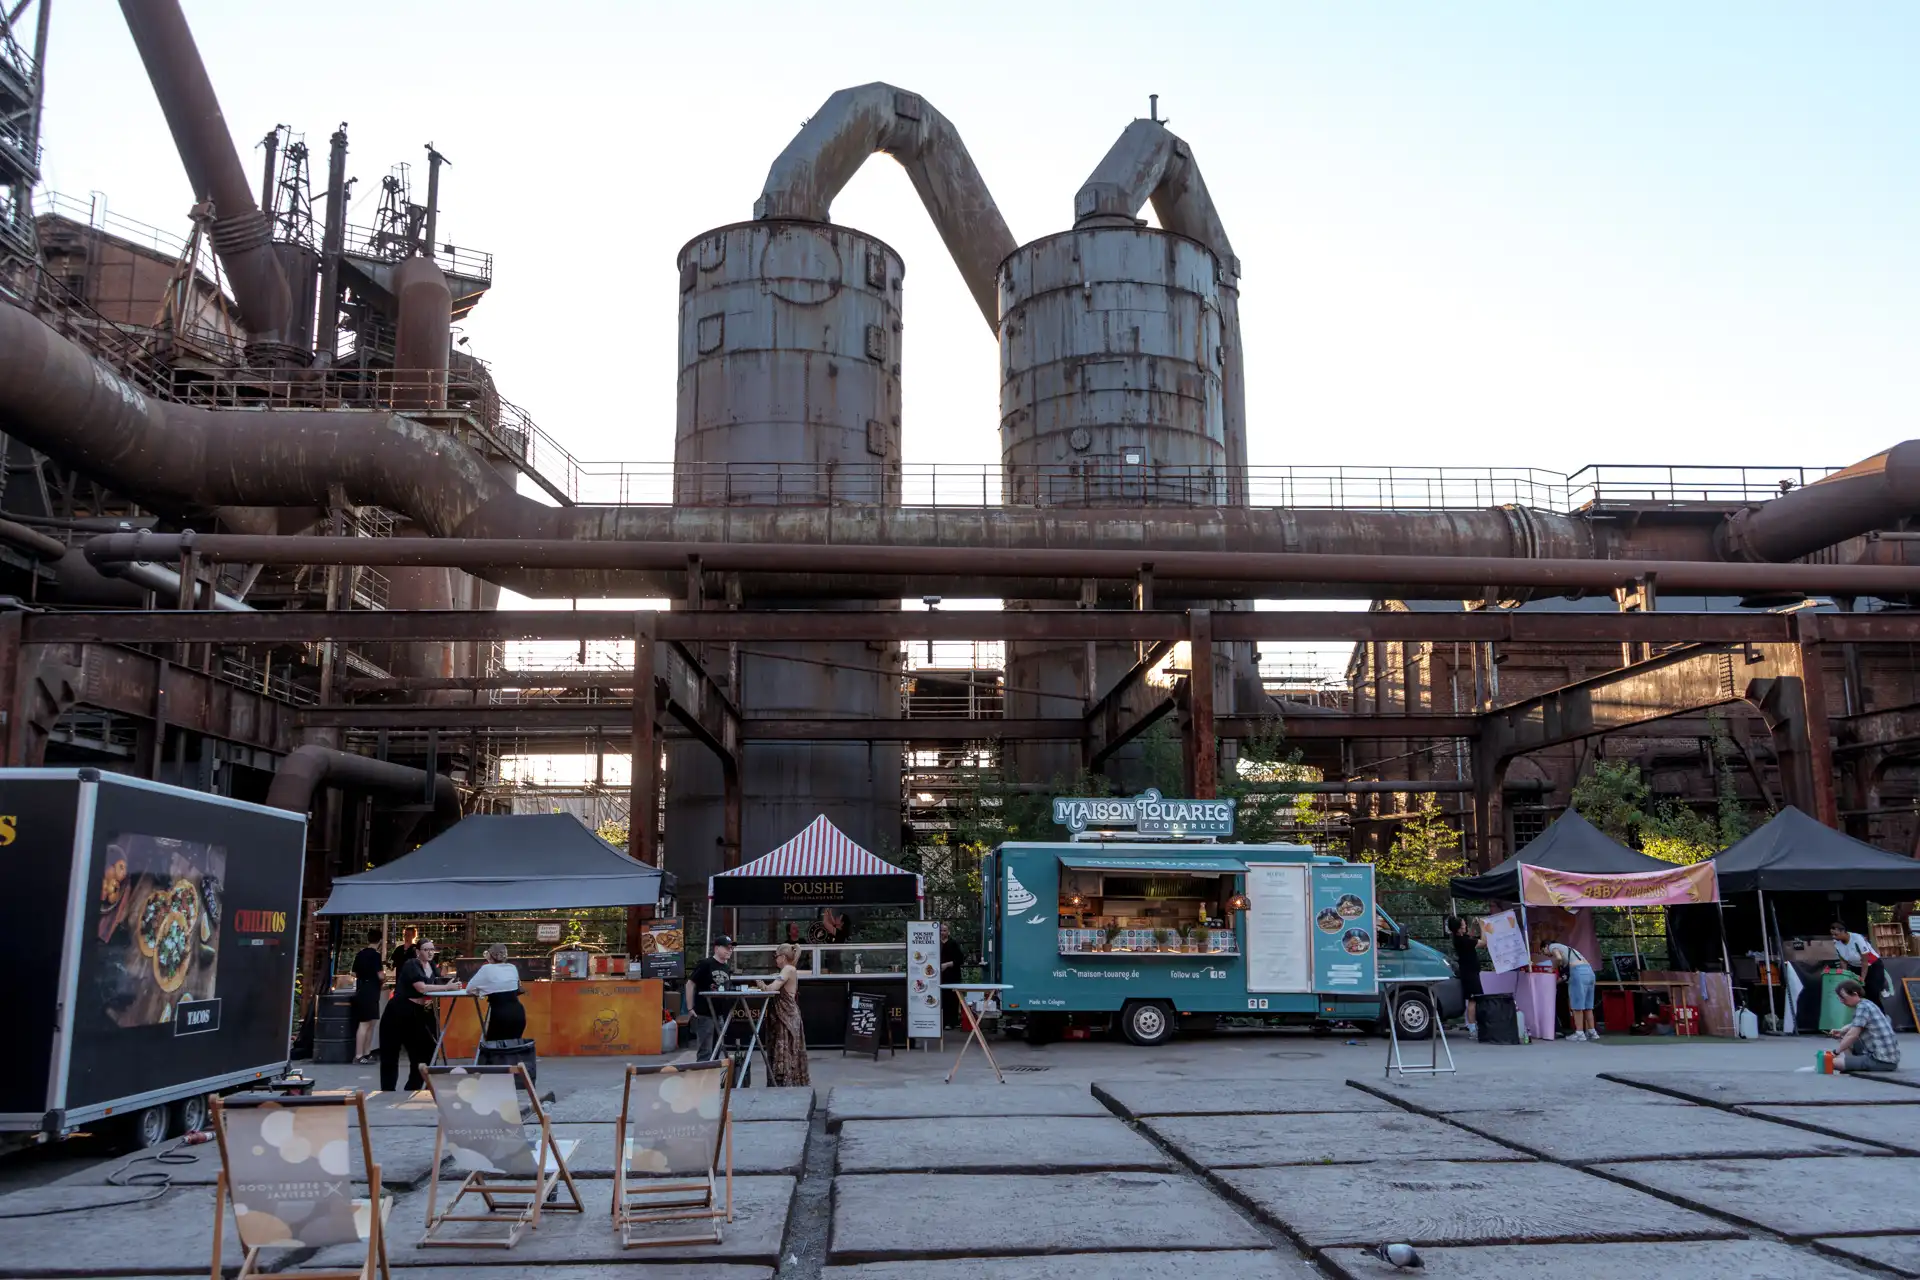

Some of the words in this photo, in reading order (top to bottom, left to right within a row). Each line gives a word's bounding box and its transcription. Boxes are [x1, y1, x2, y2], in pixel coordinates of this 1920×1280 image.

[1056, 802, 1136, 828] MAISON
[1136, 793, 1229, 821] TOUAREG
[1144, 822, 1225, 830] FOODTRUCK
[783, 882, 844, 895] POUSHE
[234, 909, 286, 934] CHILITOS
[1052, 970, 1068, 978] visit
[1077, 969, 1140, 980] maison-touareg.de
[187, 1009, 210, 1025] TACOS
